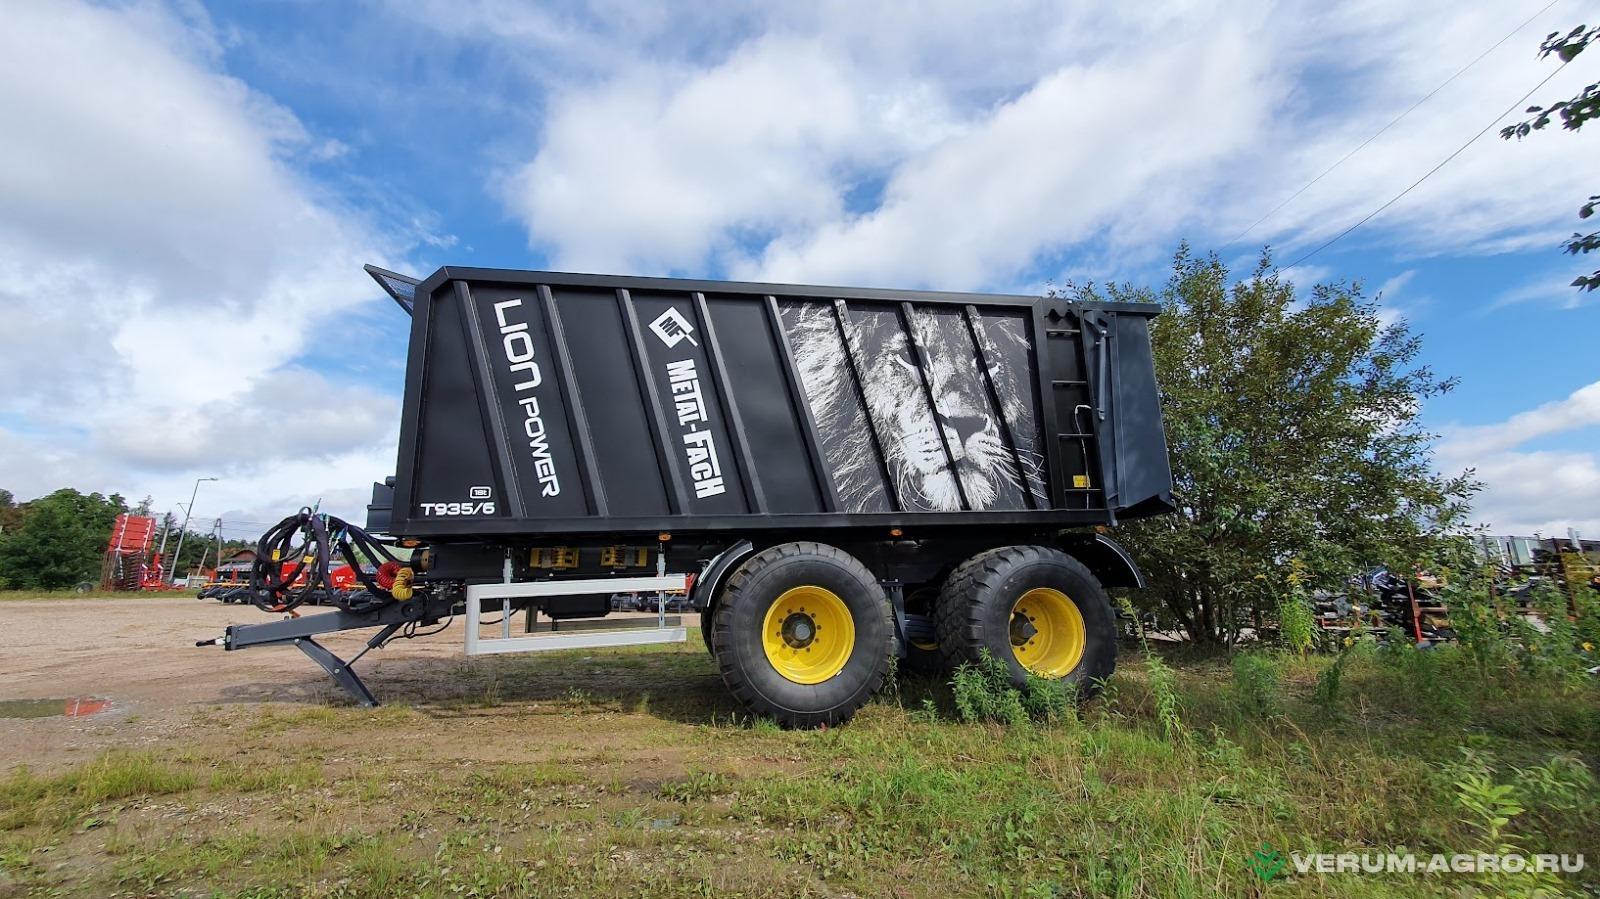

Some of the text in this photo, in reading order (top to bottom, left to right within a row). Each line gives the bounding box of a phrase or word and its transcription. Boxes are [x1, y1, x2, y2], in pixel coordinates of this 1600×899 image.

[659, 316, 687, 338] MF
[494, 299, 560, 497] LION POWER
[666, 359, 726, 499] METAL-FACH
[420, 502, 495, 516] T935/6
